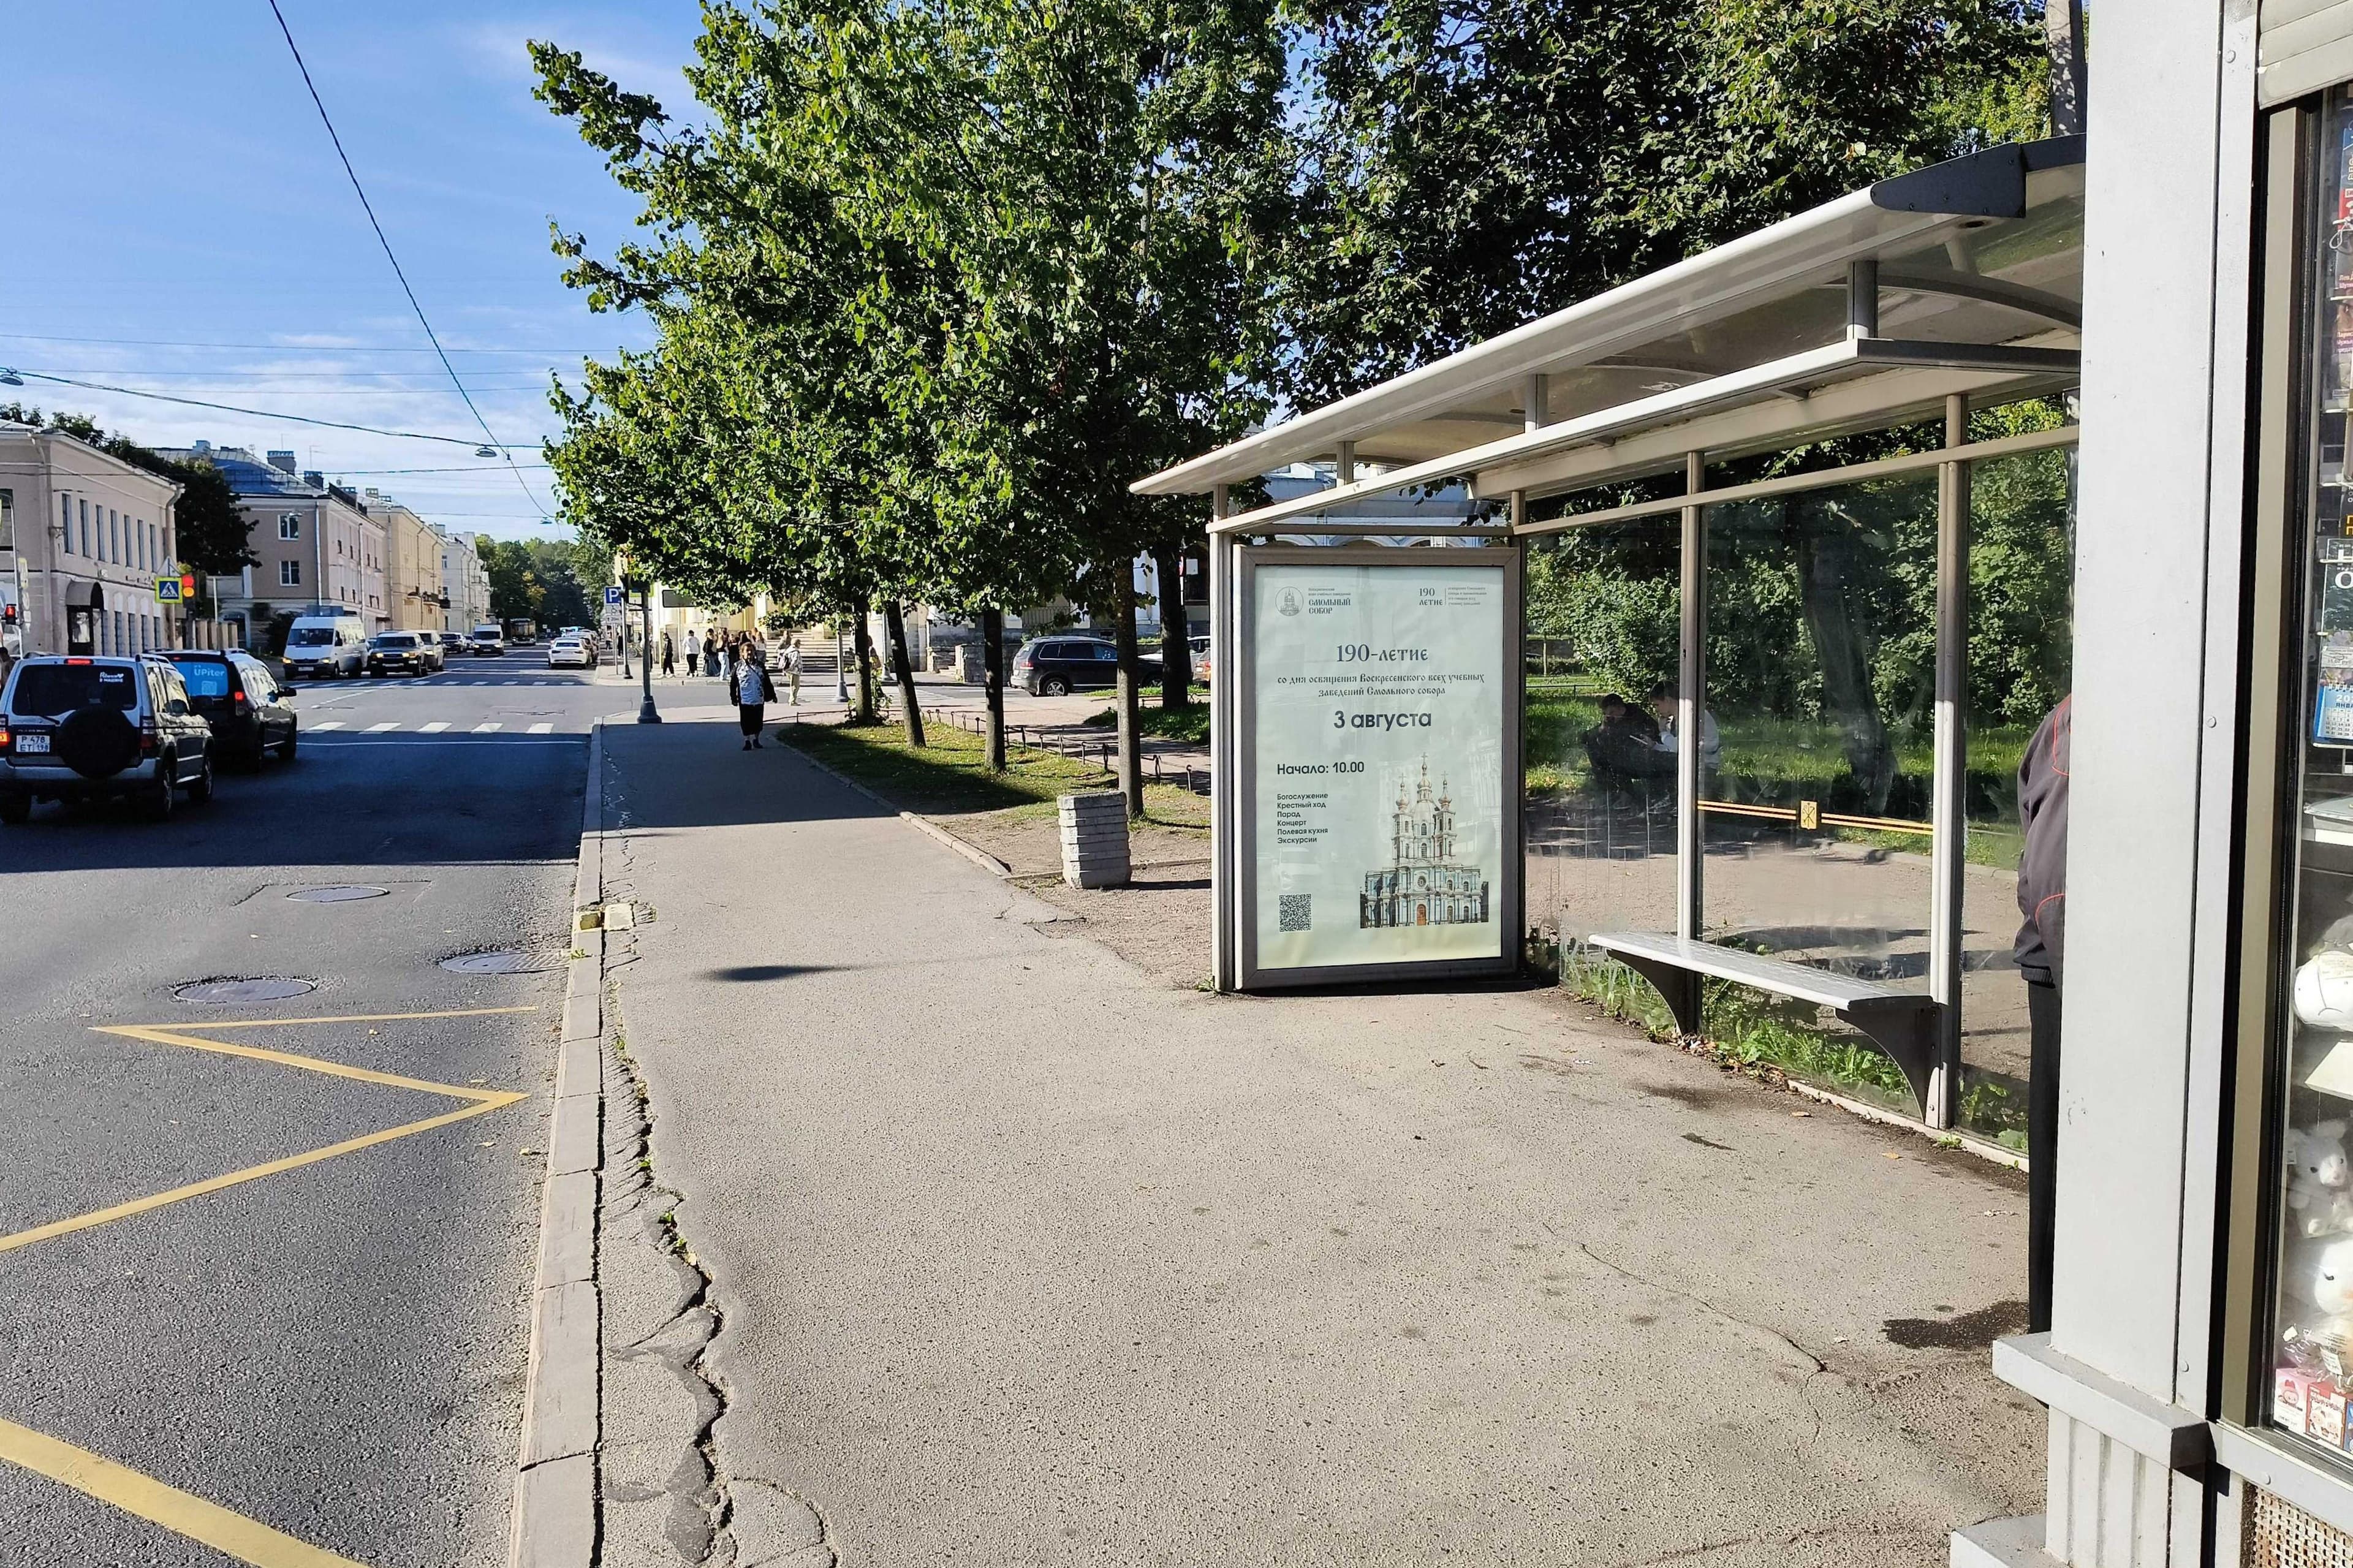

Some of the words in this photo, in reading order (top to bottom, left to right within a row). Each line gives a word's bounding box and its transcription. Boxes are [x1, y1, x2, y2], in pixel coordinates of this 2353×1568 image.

[608, 588, 619, 602] P
[1419, 588, 1435, 597] 190
[1308, 597, 1351, 606] СМОЛЬНЫЙ
[1336, 643, 1428, 662] 190-летие
[1289, 676, 1306, 684] дня
[1308, 676, 1357, 686] освящения
[1360, 673, 1426, 684] Воскресенского
[1428, 675, 1446, 684] всех
[1448, 673, 1485, 684] учебных
[1318, 686, 1365, 698] заведений
[1366, 686, 1415, 696] Смольного
[1417, 687, 1446, 697] собора
[1334, 711, 1346, 729] 3
[1351, 713, 1432, 732] августа
[1277, 763, 1329, 775] Начало:
[1332, 762, 1365, 774] 10.00
[1277, 801, 1311, 809] Крестный
